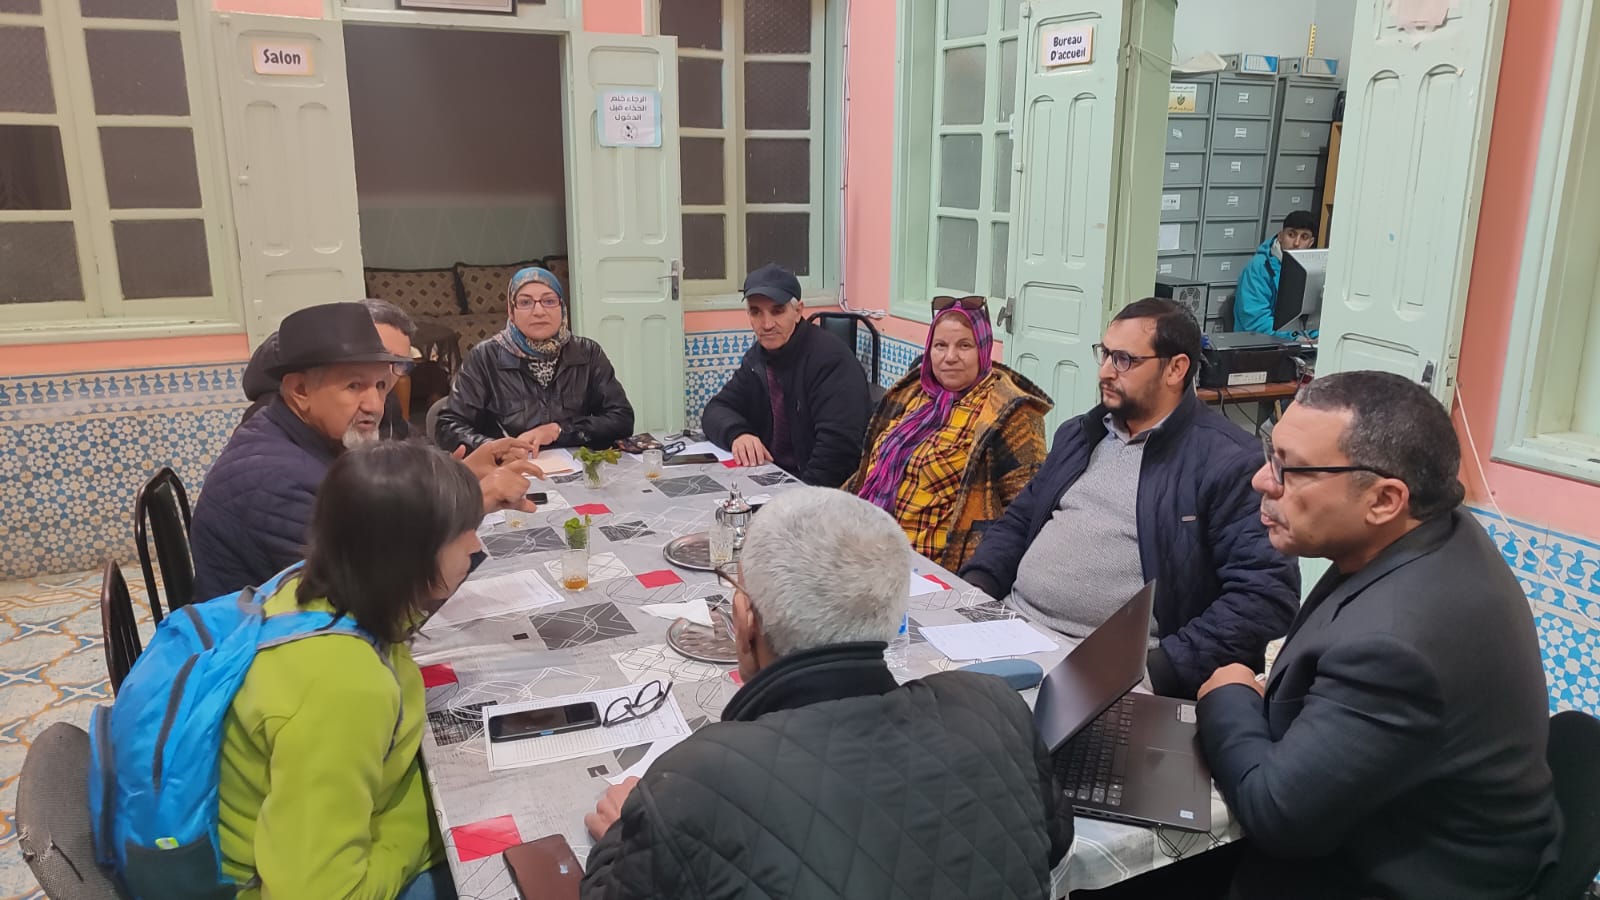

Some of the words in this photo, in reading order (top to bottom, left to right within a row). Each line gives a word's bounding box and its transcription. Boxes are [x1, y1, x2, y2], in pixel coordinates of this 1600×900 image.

[1053, 36, 1082, 47] Bureau
[263, 48, 301, 65] Salon
[1050, 47, 1086, 61] D'accueil
[614, 113, 642, 121] الدخول
